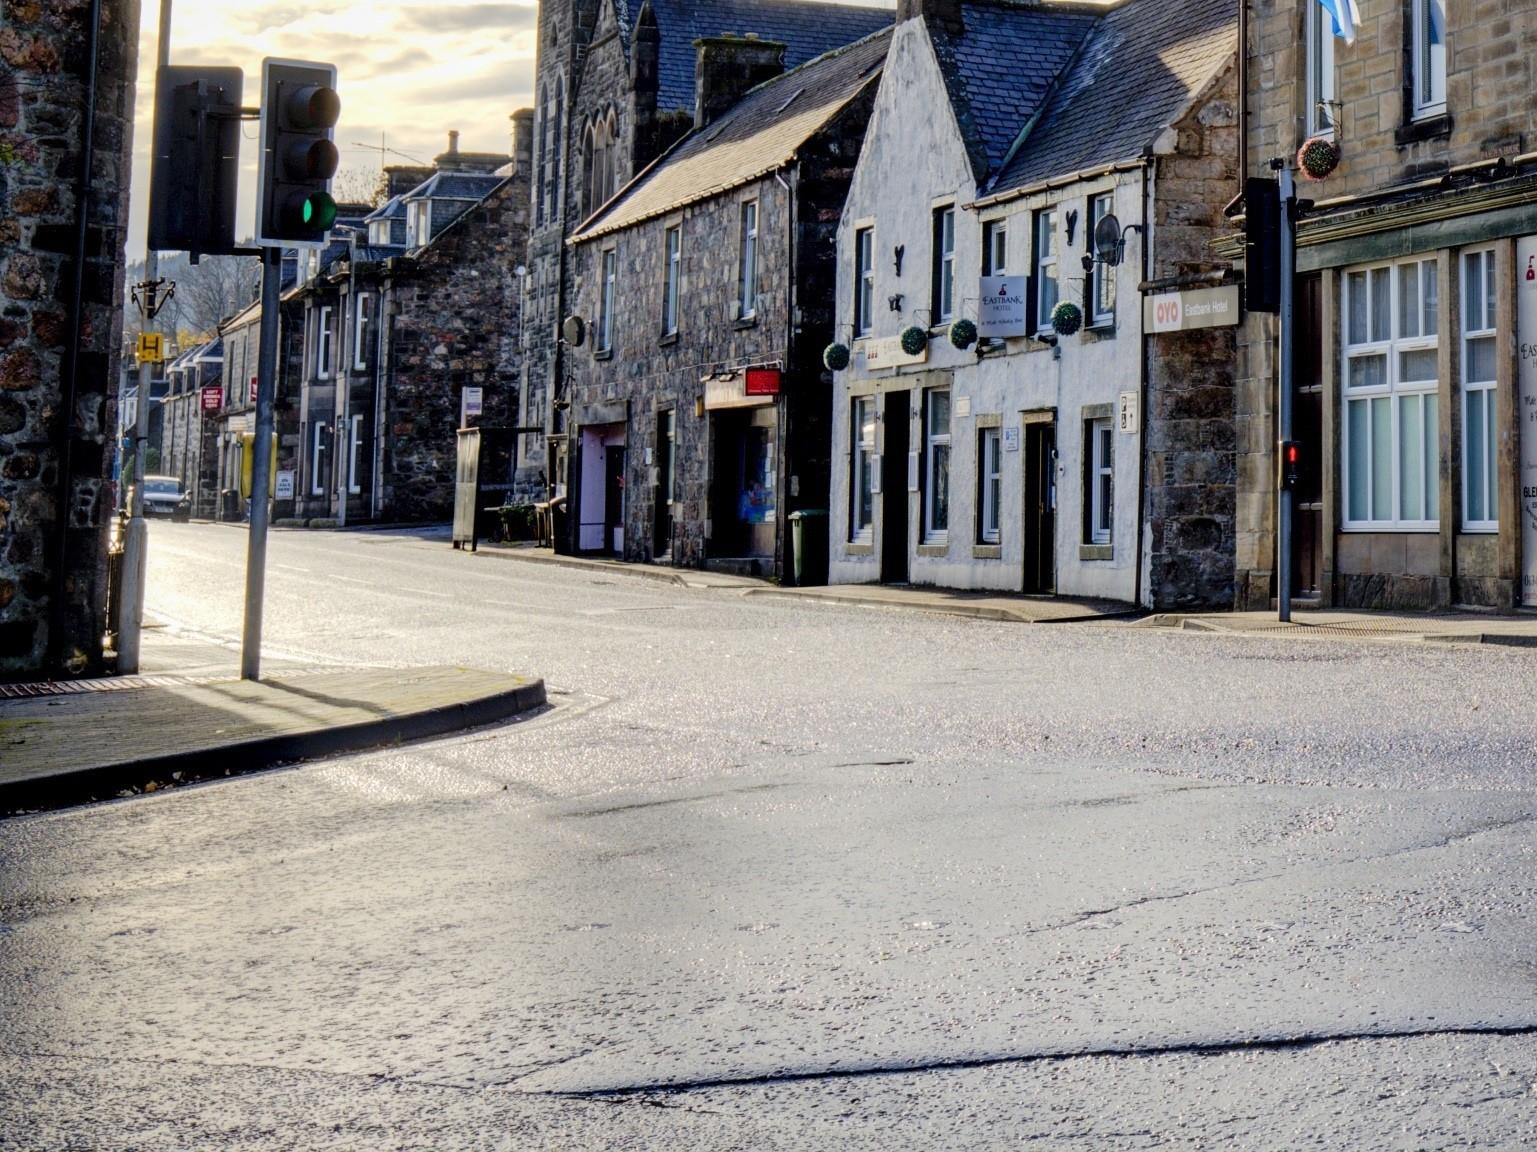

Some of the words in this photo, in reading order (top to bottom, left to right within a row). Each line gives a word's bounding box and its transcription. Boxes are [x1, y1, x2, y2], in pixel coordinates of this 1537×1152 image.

[1157, 301, 1178, 323] OYO
[1212, 298, 1228, 312] Hotel
[142, 336, 159, 354] H
